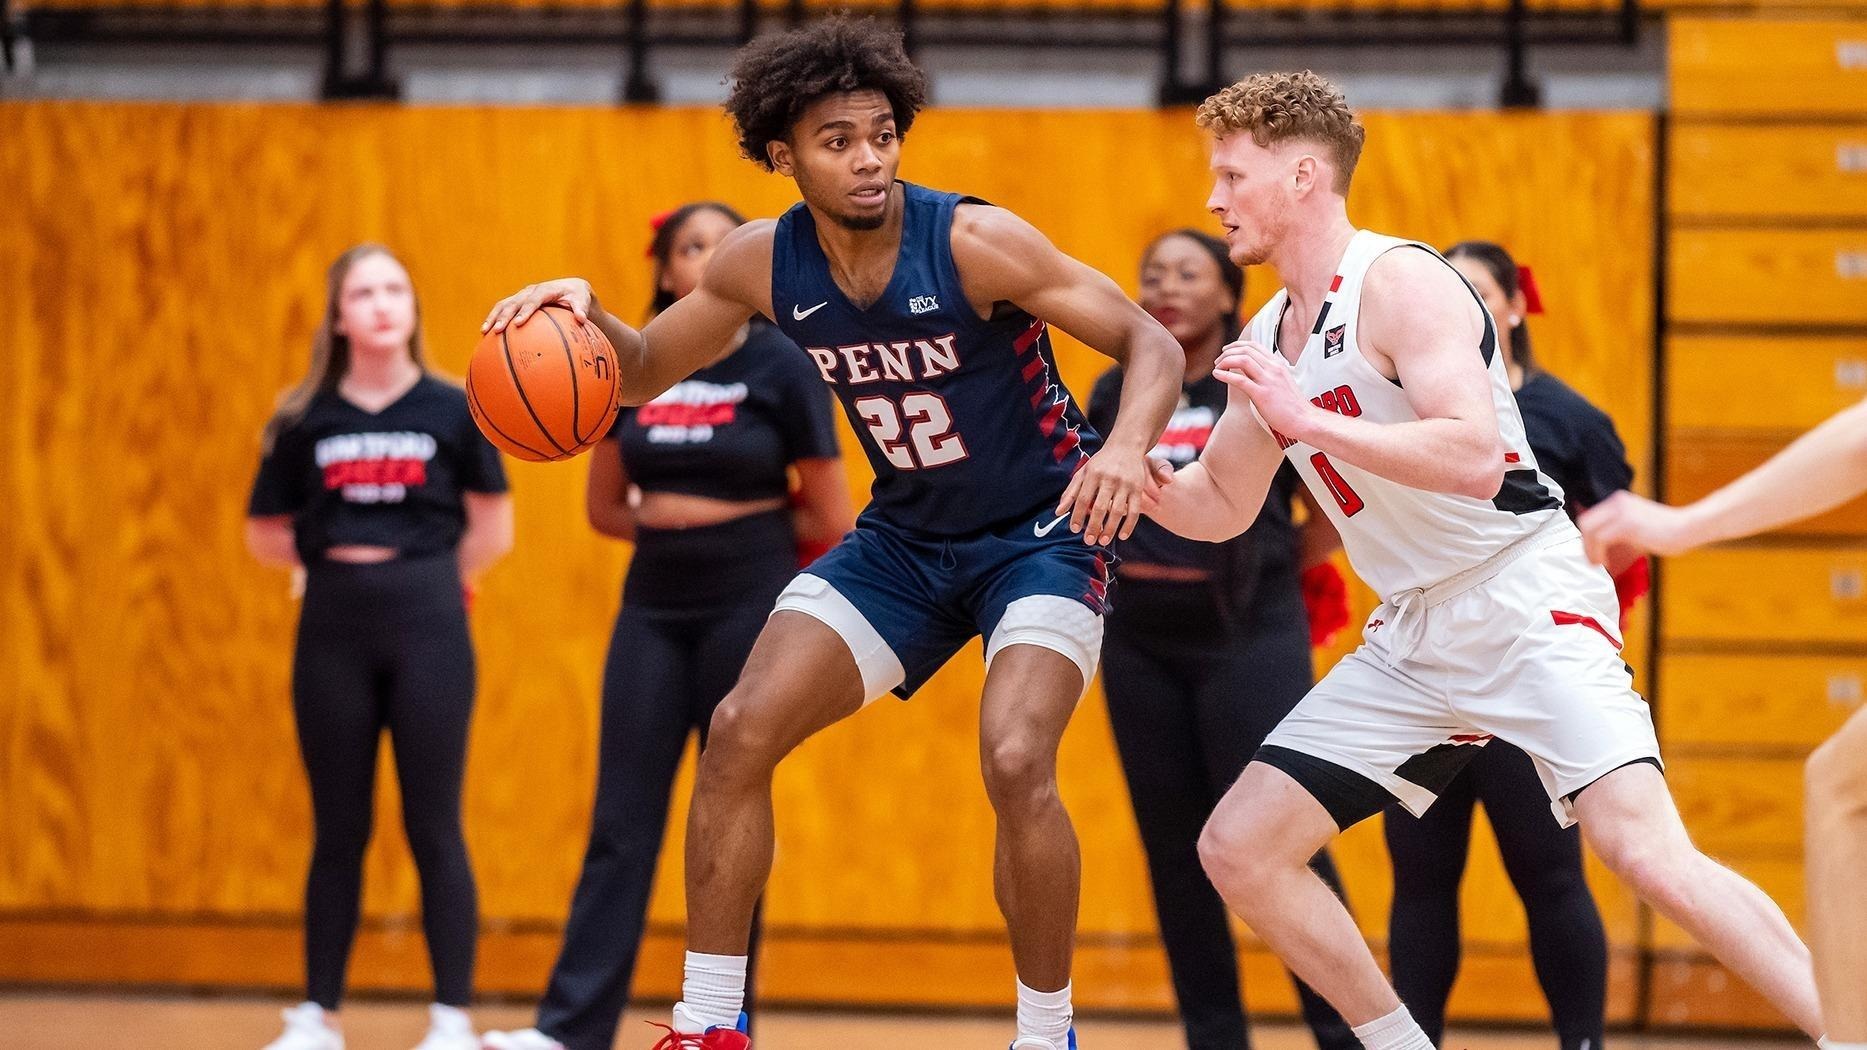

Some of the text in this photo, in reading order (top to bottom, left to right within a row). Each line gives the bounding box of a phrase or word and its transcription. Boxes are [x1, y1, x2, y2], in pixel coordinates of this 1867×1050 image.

[917, 295, 937, 311] IVY
[805, 333, 961, 384] PENN
[854, 391, 969, 471] 22
[1310, 451, 1365, 518] 0
